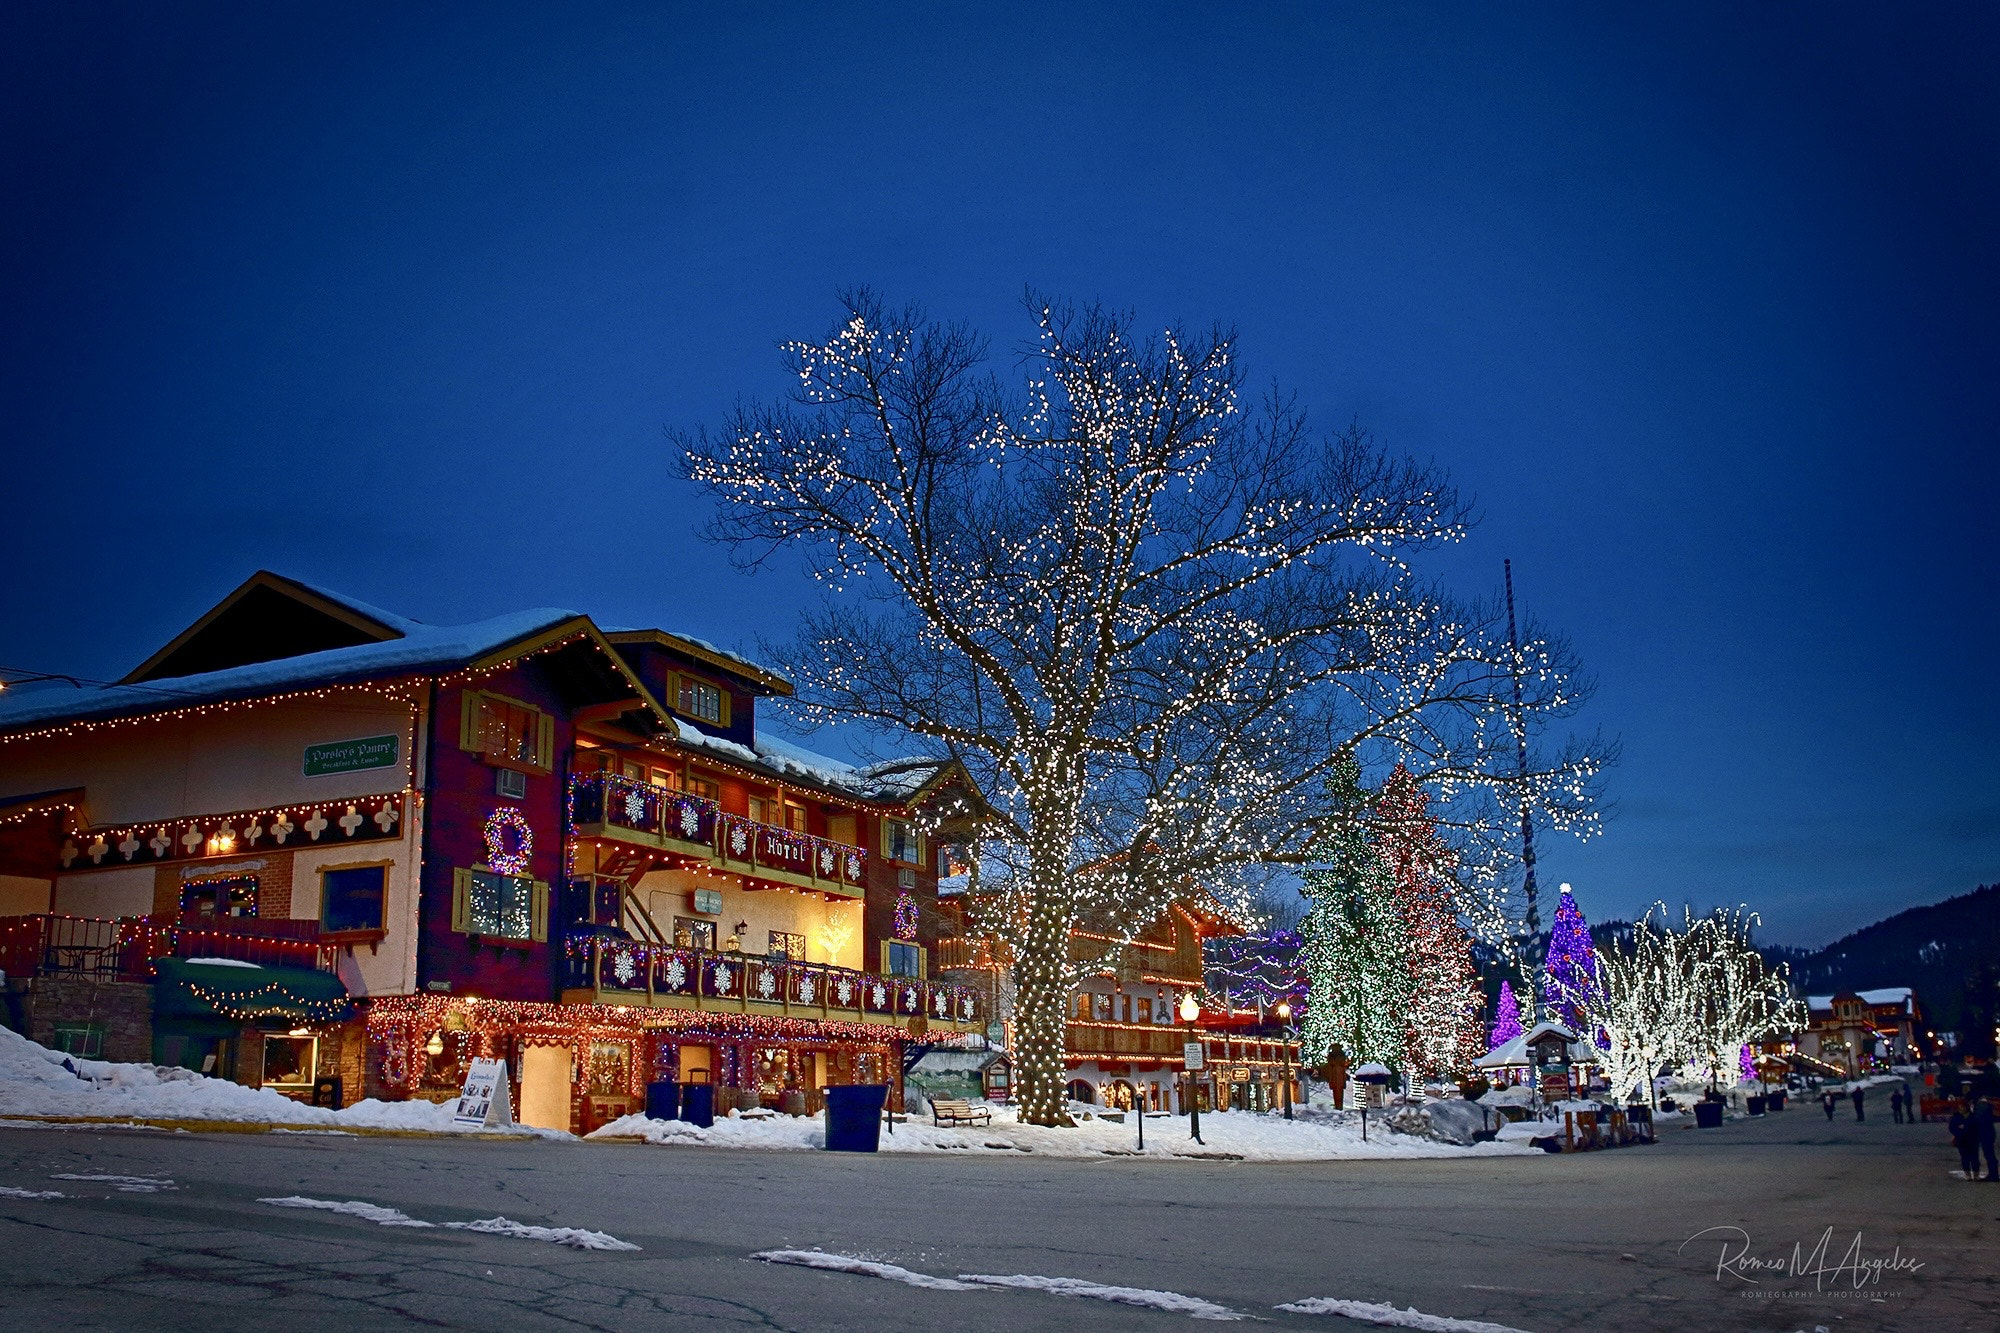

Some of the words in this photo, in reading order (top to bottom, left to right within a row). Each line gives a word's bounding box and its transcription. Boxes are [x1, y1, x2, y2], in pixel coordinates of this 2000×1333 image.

[312, 747, 355, 763] Parsley's
[357, 743, 391, 757] Pantry
[351, 758, 359, 766] &
[360, 756, 380, 765] Lunch
